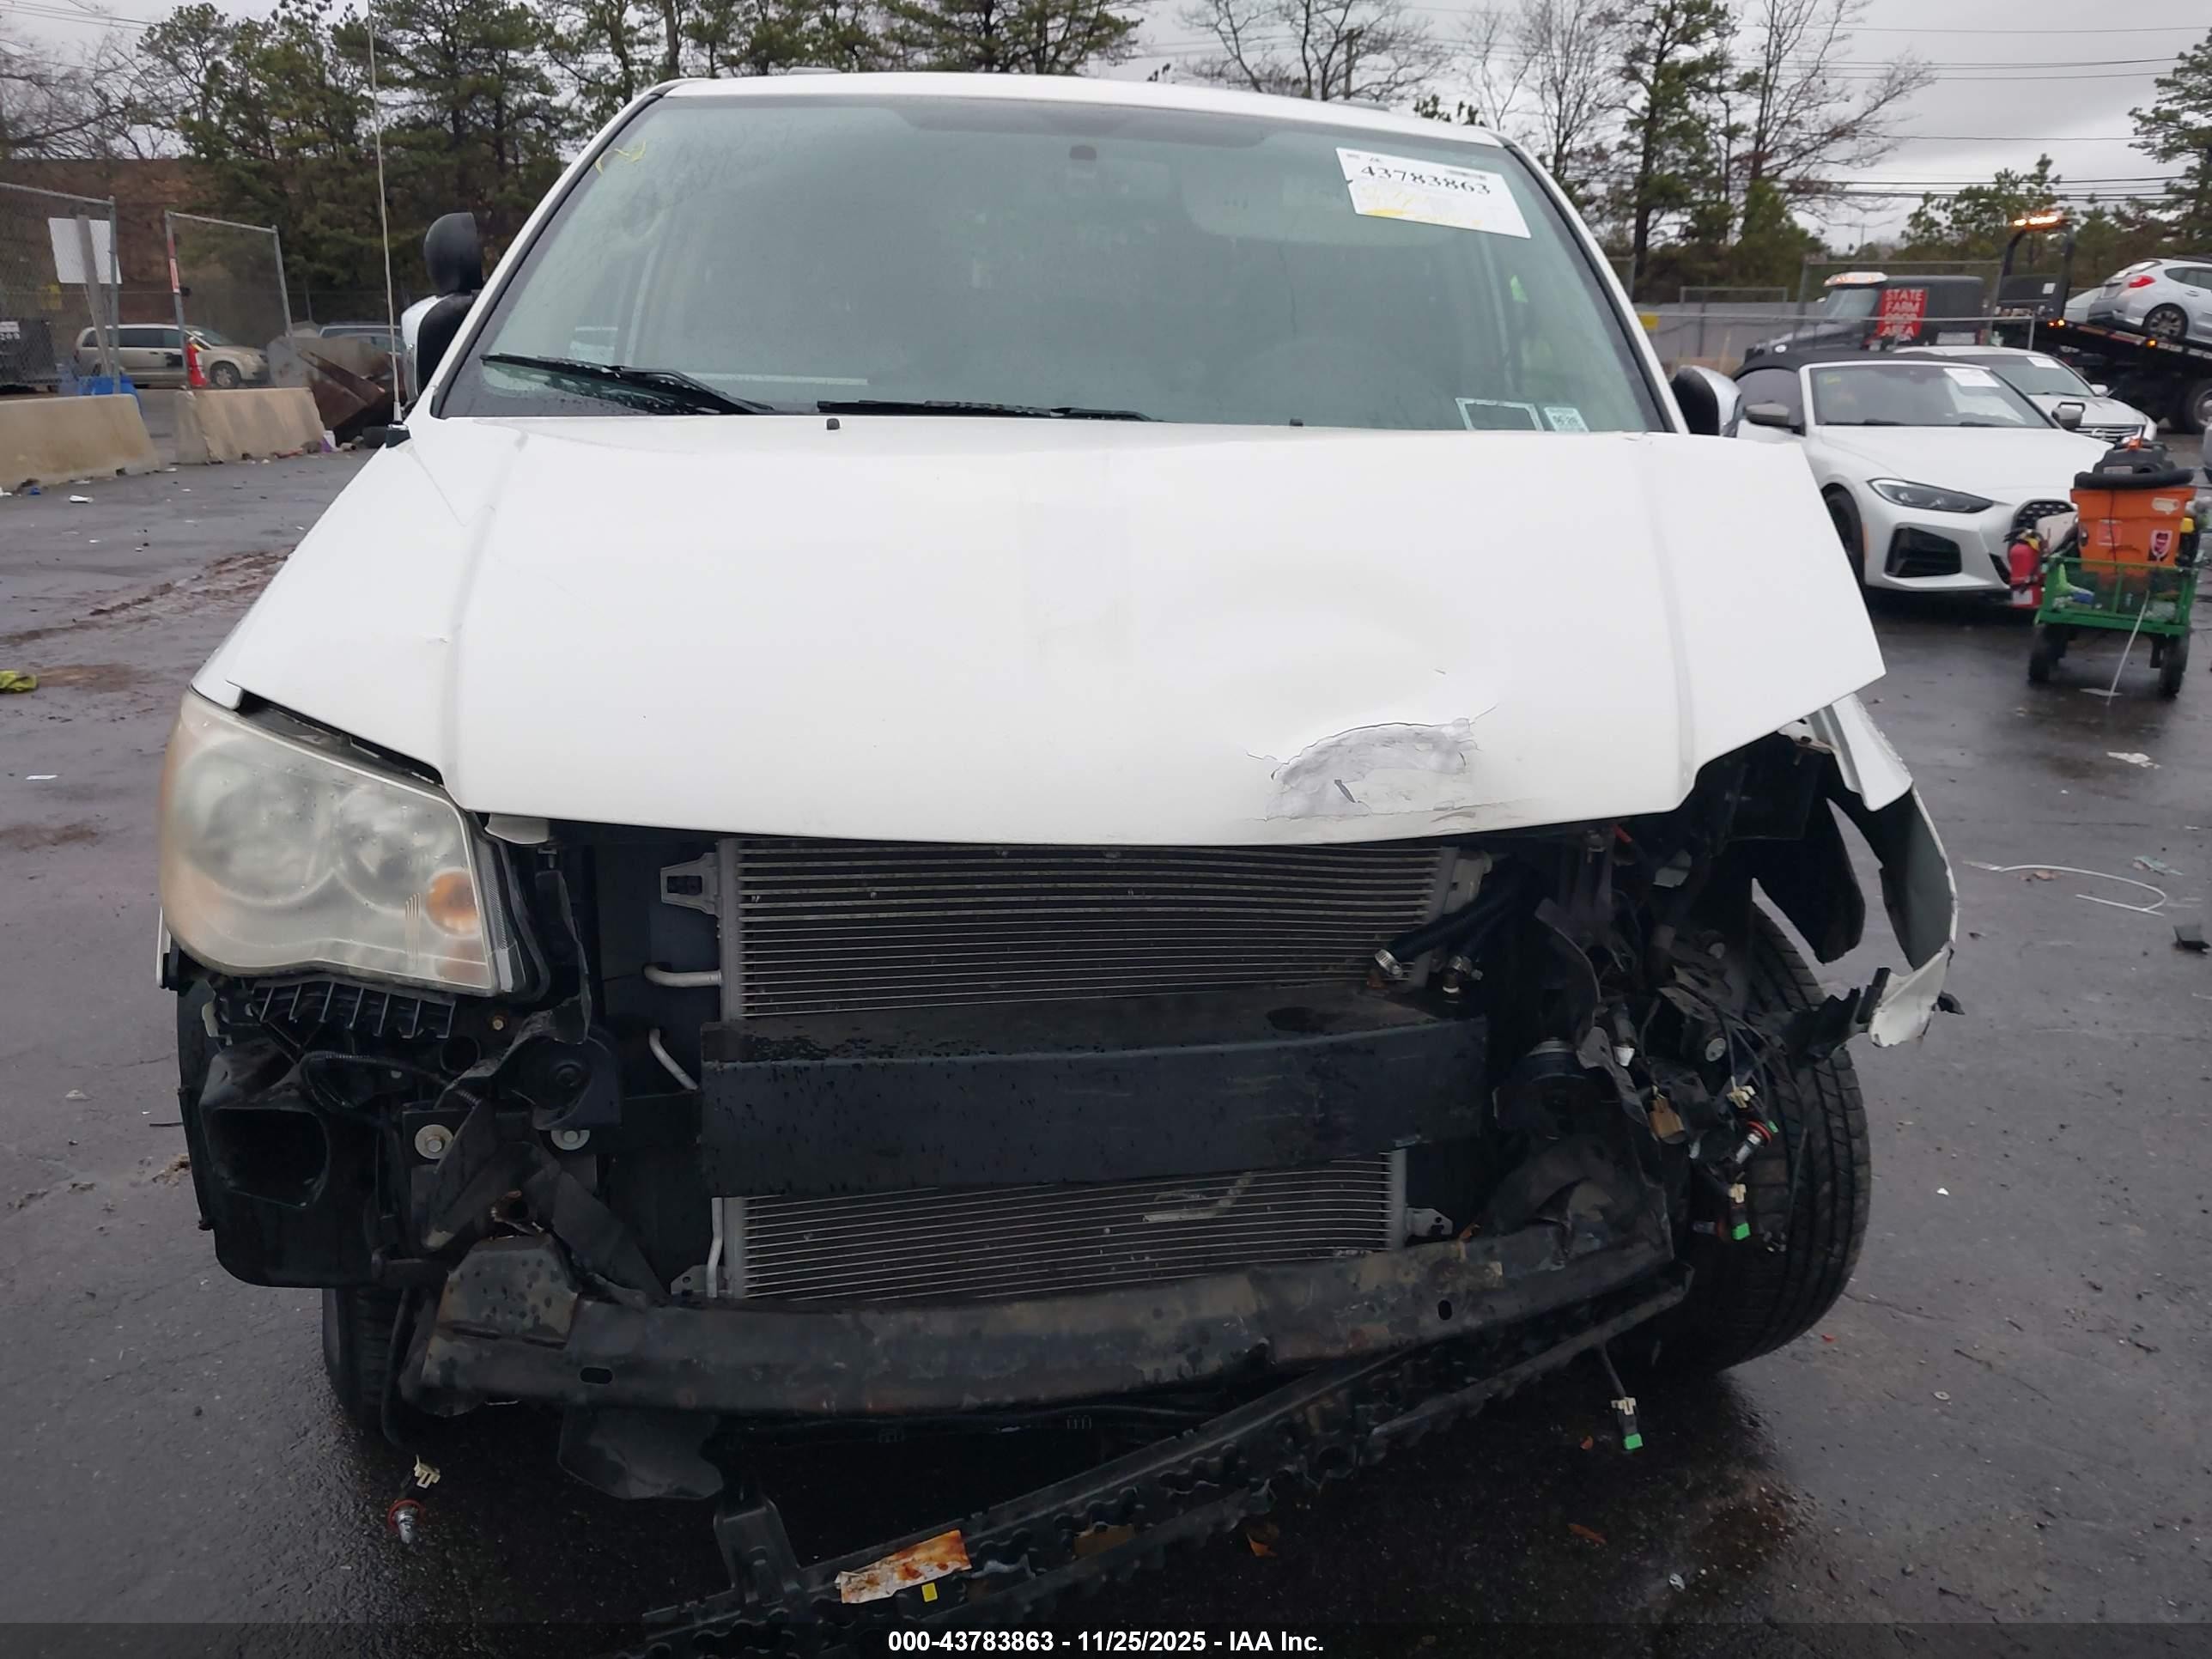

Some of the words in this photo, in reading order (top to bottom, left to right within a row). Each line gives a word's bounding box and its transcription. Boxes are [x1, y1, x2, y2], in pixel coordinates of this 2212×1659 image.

[1360, 165, 1492, 196] 43783863
[1885, 289, 1924, 301] STATE
[1884, 301, 1921, 313] FARM
